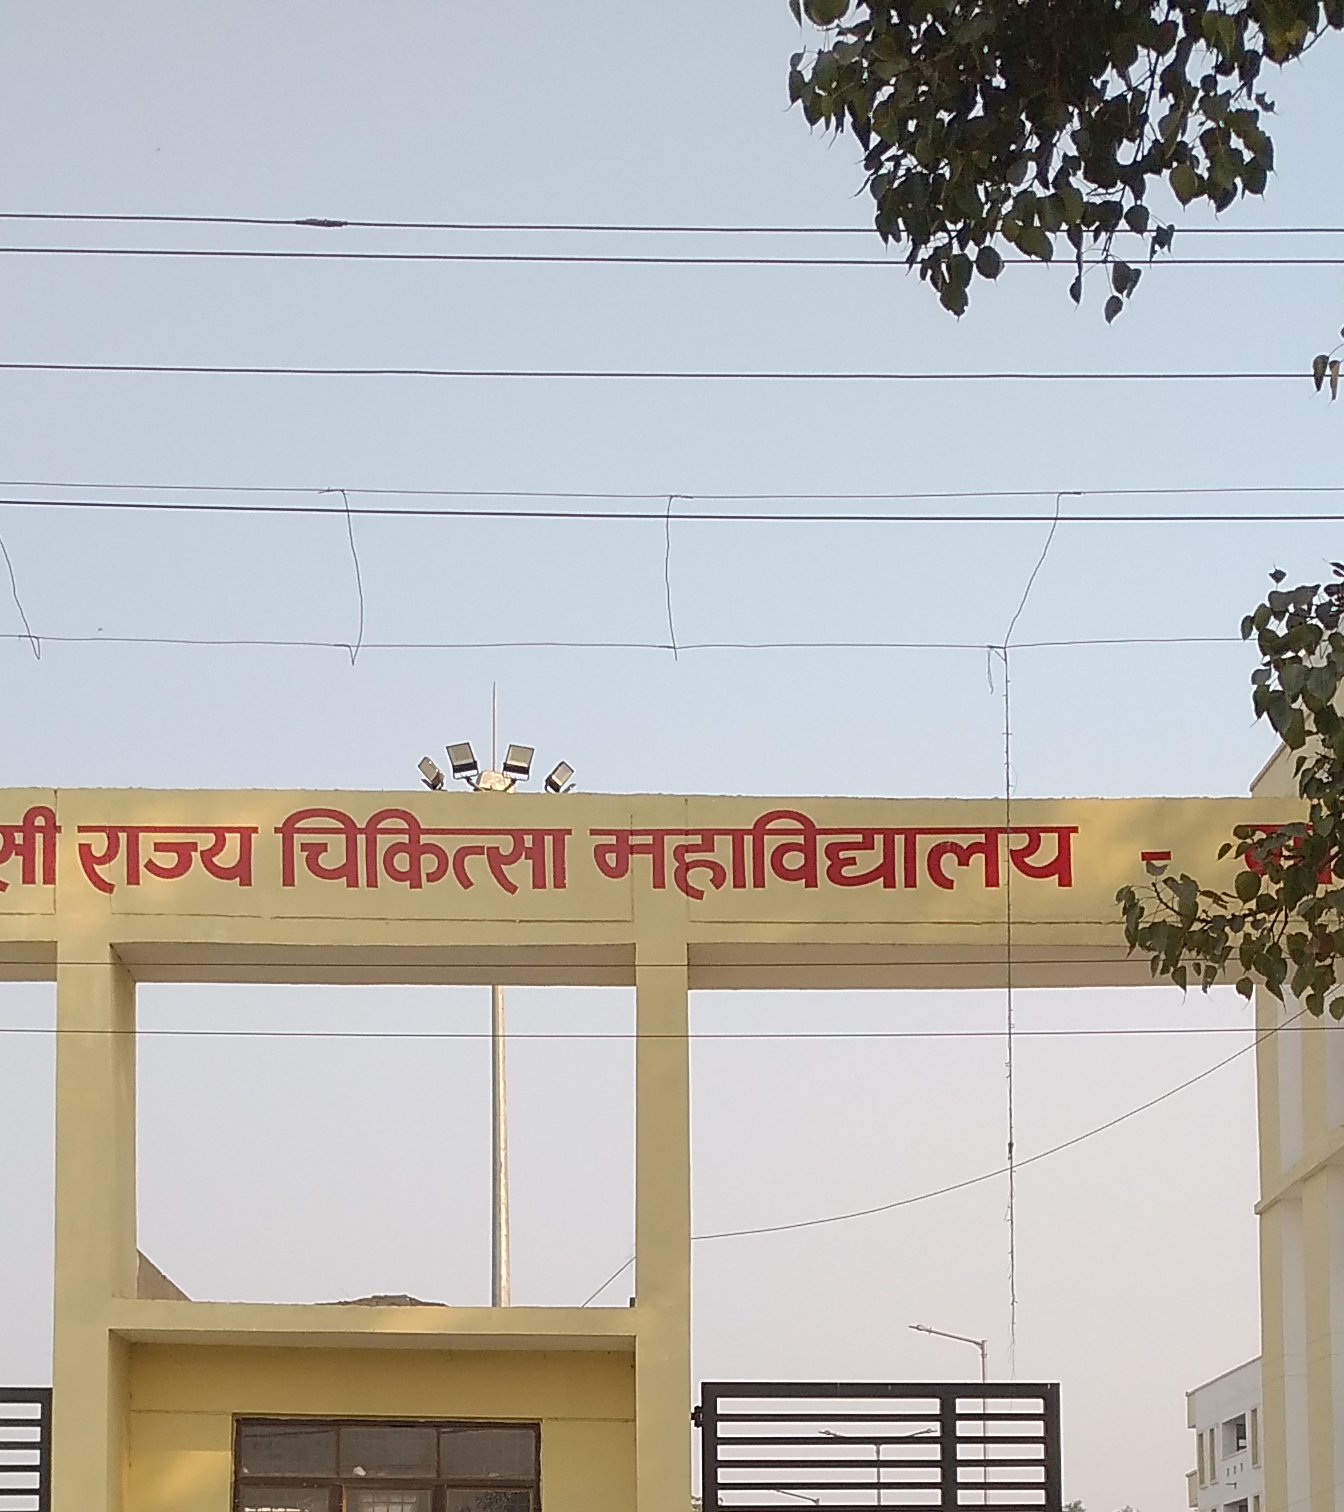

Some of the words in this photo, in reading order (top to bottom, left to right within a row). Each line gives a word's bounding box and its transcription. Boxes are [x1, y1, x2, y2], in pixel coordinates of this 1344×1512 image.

[77, 824, 259, 895] राज्य
[273, 808, 572, 896] चिकित्सा
[589, 809, 1079, 901] महाविद्यालय
